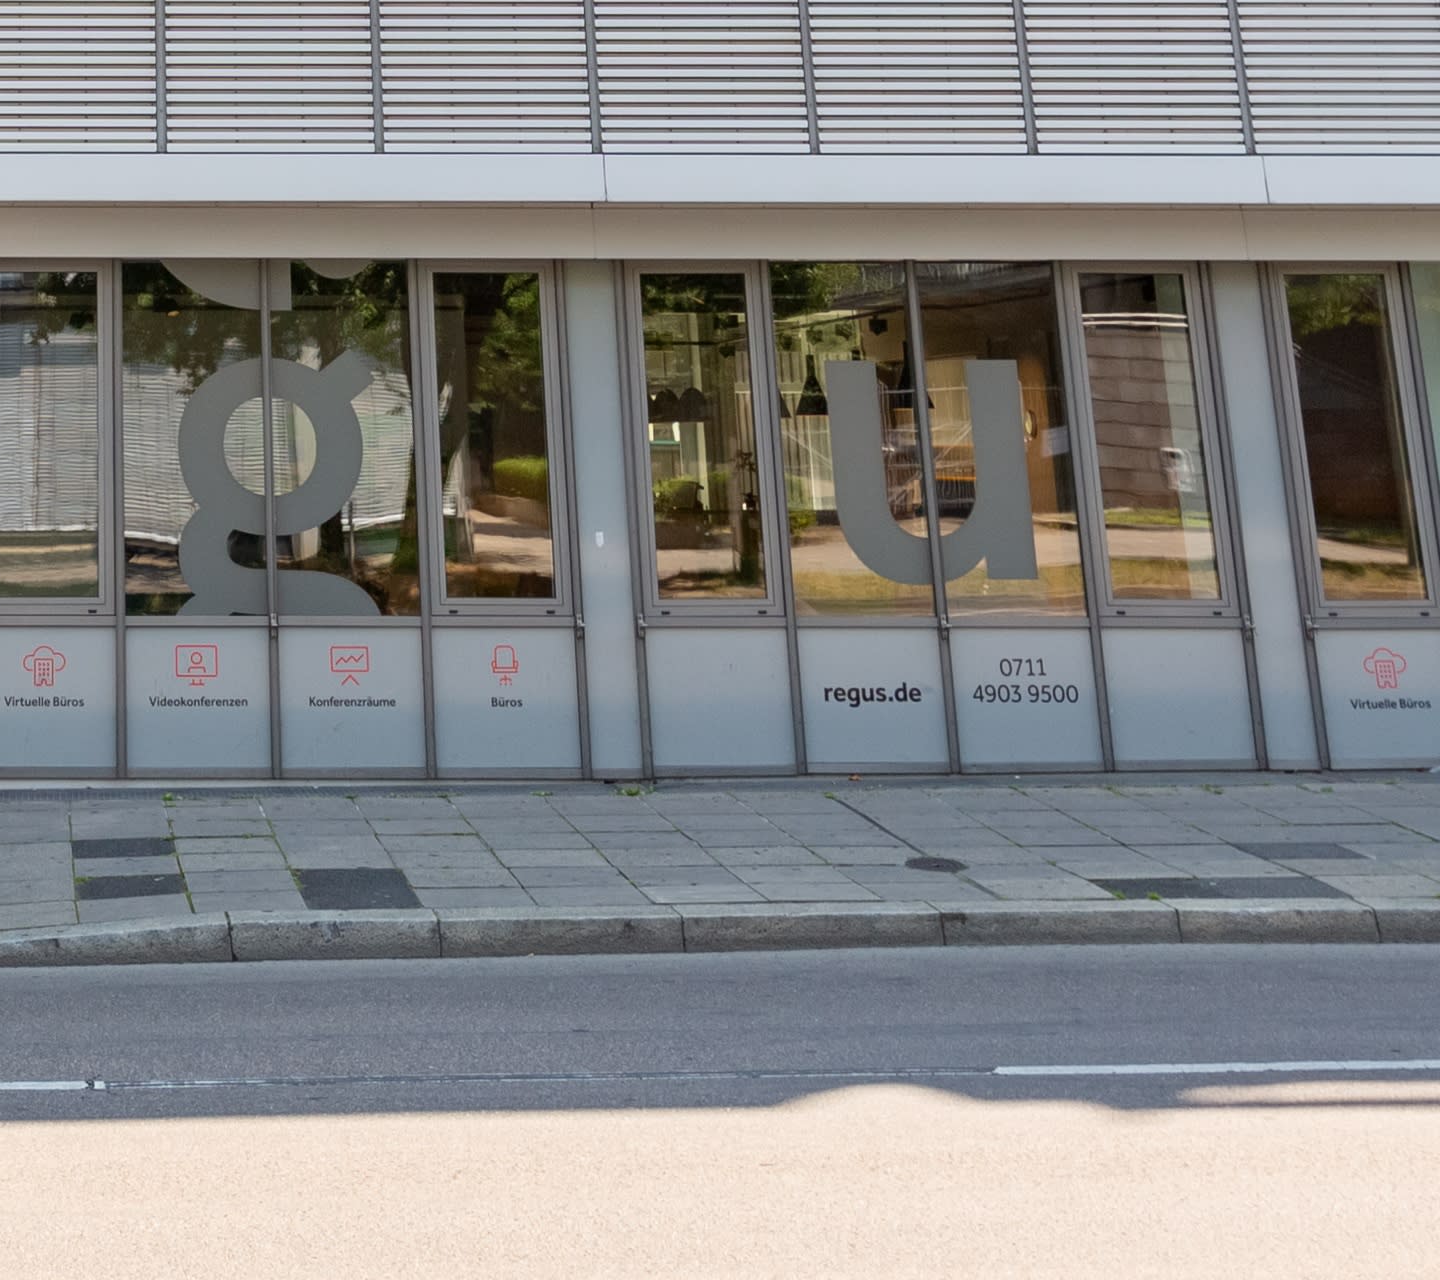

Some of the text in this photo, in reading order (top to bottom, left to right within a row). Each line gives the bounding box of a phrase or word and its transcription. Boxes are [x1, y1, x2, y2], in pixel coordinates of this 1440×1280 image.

[999, 657, 1047, 677] 0711
[823, 682, 922, 708] regus.de
[972, 684, 1079, 704] 4903 9500
[4, 696, 84, 708] Virtuelle Büros
[148, 696, 248, 708] Videokonferenzen
[308, 696, 396, 708] Konferenzräume
[491, 696, 523, 708] Büros
[1350, 698, 1431, 710] Virtuelle Büros
